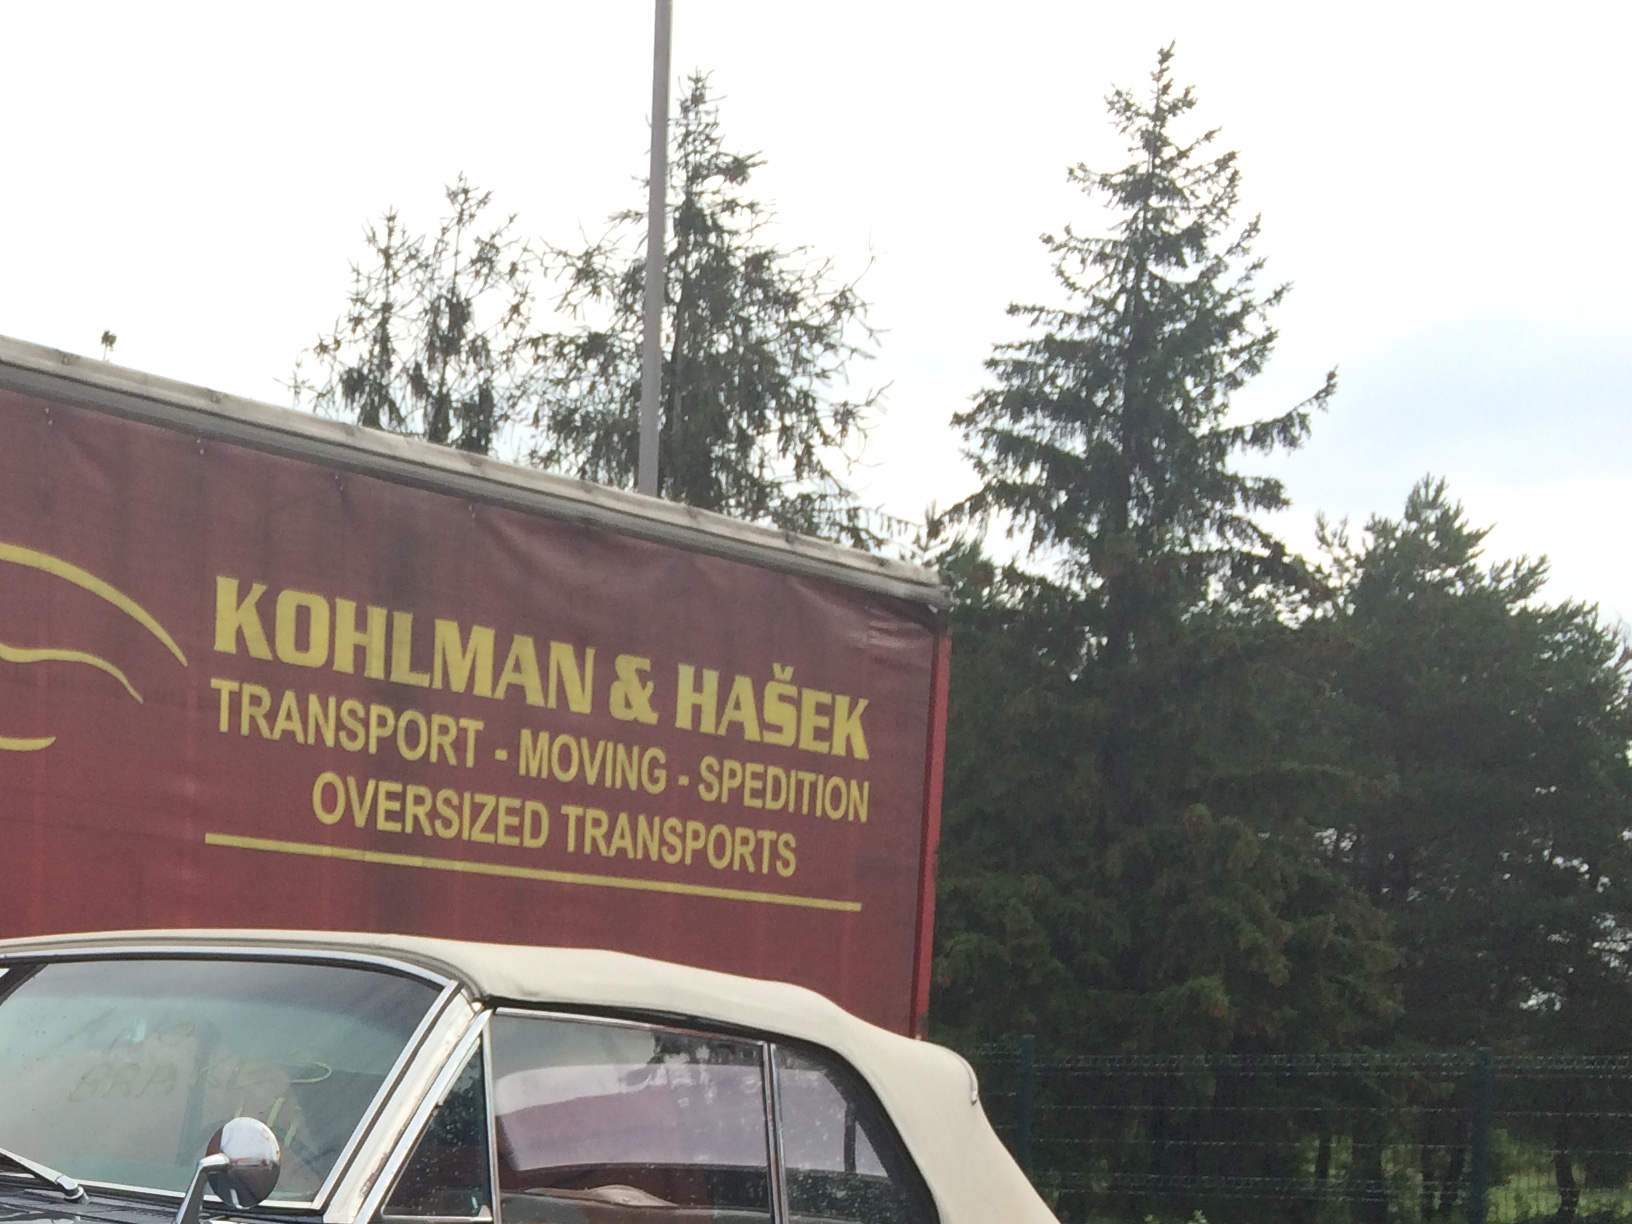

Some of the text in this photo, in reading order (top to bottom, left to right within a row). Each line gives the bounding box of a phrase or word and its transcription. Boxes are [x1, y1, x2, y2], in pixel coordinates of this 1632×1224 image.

[214, 575, 870, 760] KOHLMAN & HAŠEK
[211, 678, 483, 768] TRANSPORT
[519, 729, 666, 794] MOVING
[699, 756, 870, 822] SPEDITION
[313, 771, 796, 878] OVERSIZED TRANSPORTS
